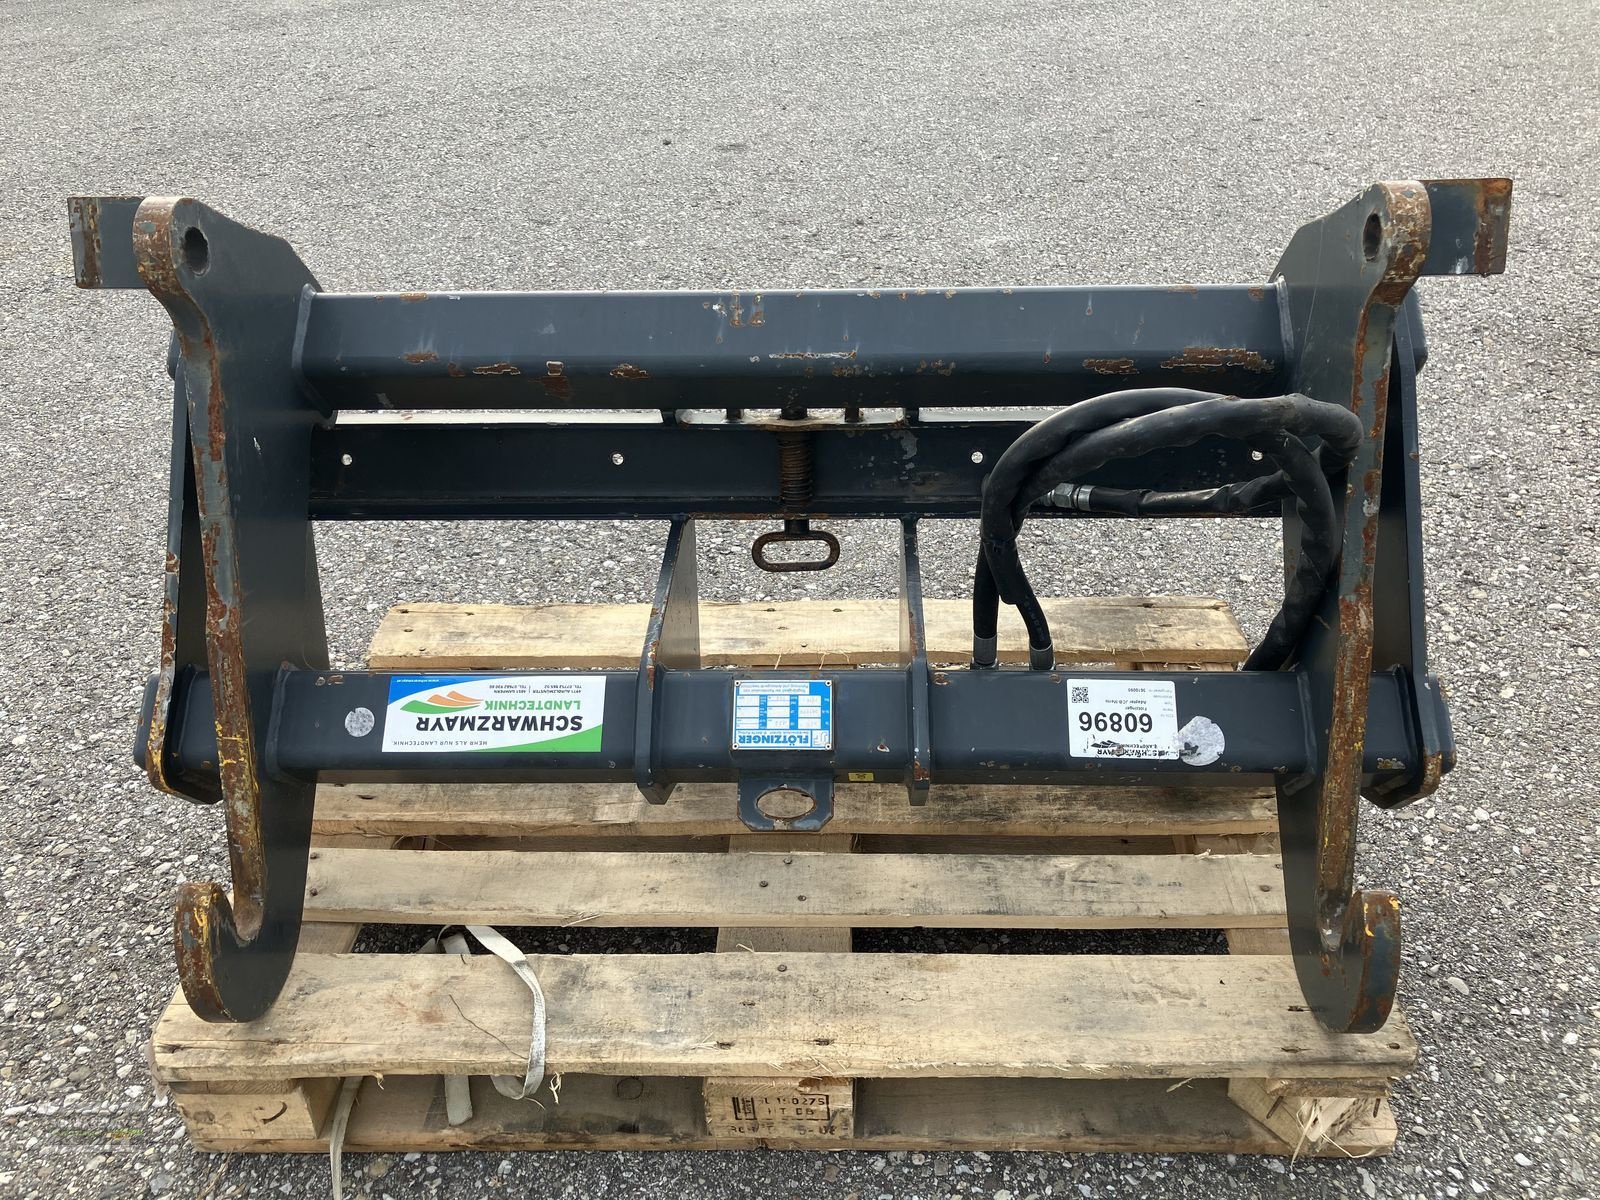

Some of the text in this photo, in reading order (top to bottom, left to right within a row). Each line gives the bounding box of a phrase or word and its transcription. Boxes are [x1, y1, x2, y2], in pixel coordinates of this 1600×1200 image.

[484, 700, 581, 711] LANDTECHNIK
[415, 715, 584, 732] SCHWARZMAYR
[1078, 712, 1153, 733] 60896
[738, 735, 809, 747] FLÖTZINGER
